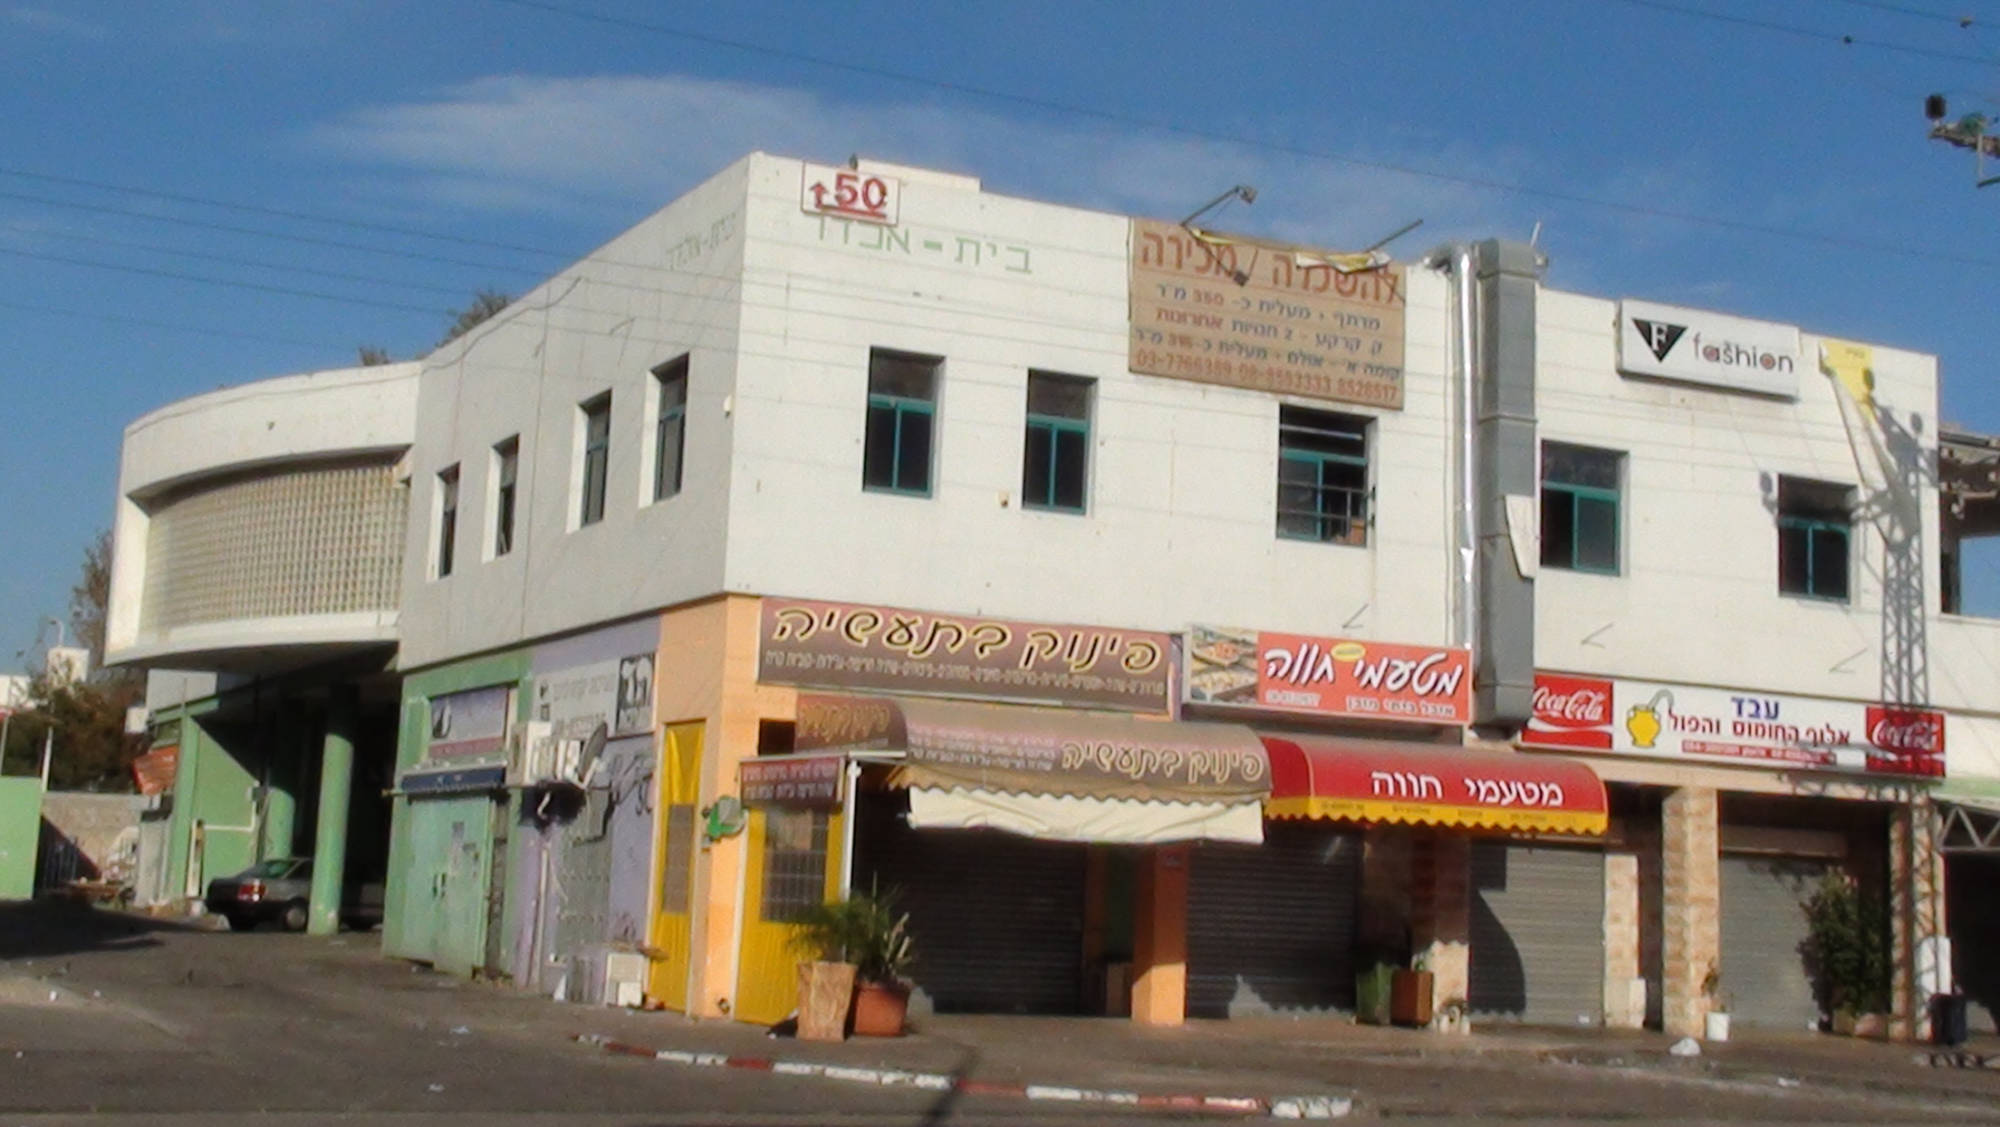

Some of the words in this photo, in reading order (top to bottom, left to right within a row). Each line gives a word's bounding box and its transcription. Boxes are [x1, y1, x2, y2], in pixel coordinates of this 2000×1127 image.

[834, 172, 888, 209] 50
[954, 236, 1033, 274] בית
[1142, 230, 1238, 278] מכירה
[1650, 323, 1668, 351] F
[771, 605, 1015, 659] בתעשיה
[1019, 629, 1165, 675] פינוק
[1263, 642, 1336, 687] חווה
[1352, 652, 1464, 697] מטעמי
[1668, 704, 1721, 734] והפול
[1731, 697, 1780, 720] עבד
[1732, 720, 1800, 744] החומוס
[1805, 723, 1851, 747] אלוף
[1060, 738, 1182, 780] בתעשיה
[1187, 745, 1264, 784] פינוק
[1371, 770, 1443, 799] חווה
[1463, 775, 1564, 807] מטעמי
